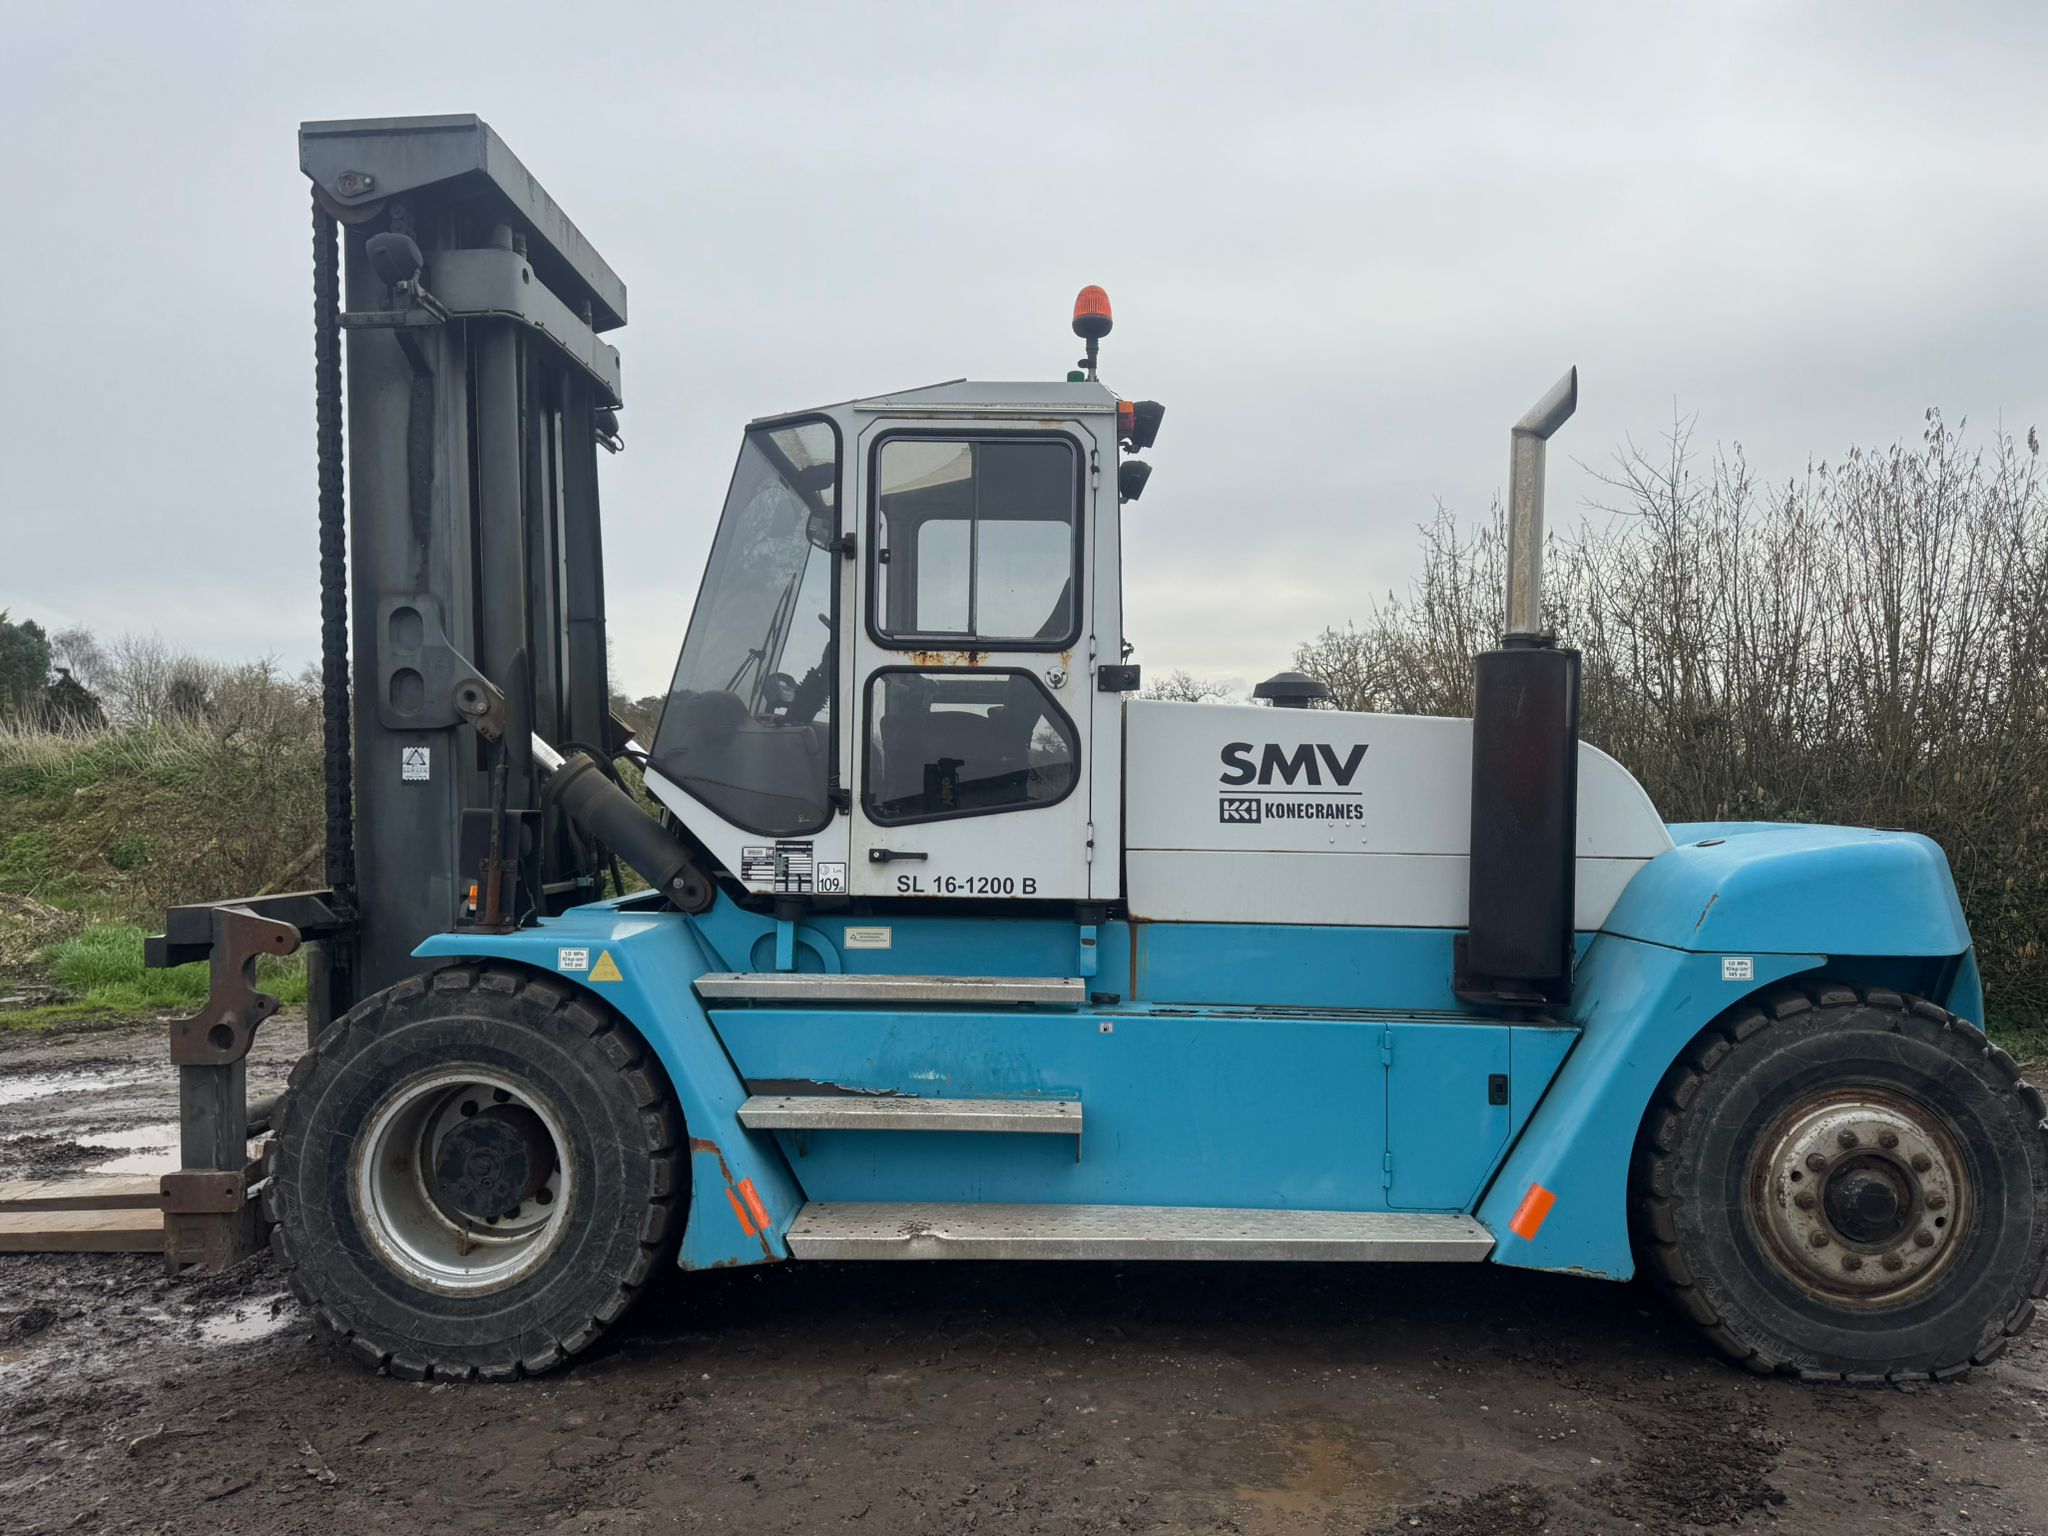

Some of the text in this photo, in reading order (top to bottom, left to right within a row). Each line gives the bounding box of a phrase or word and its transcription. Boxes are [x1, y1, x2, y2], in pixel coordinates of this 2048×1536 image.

[1219, 742, 1369, 786] SMV
[1265, 803, 1363, 820] KONECRANES
[819, 877, 840, 891] 109
[897, 875, 1037, 895] SL 16-1200 B
